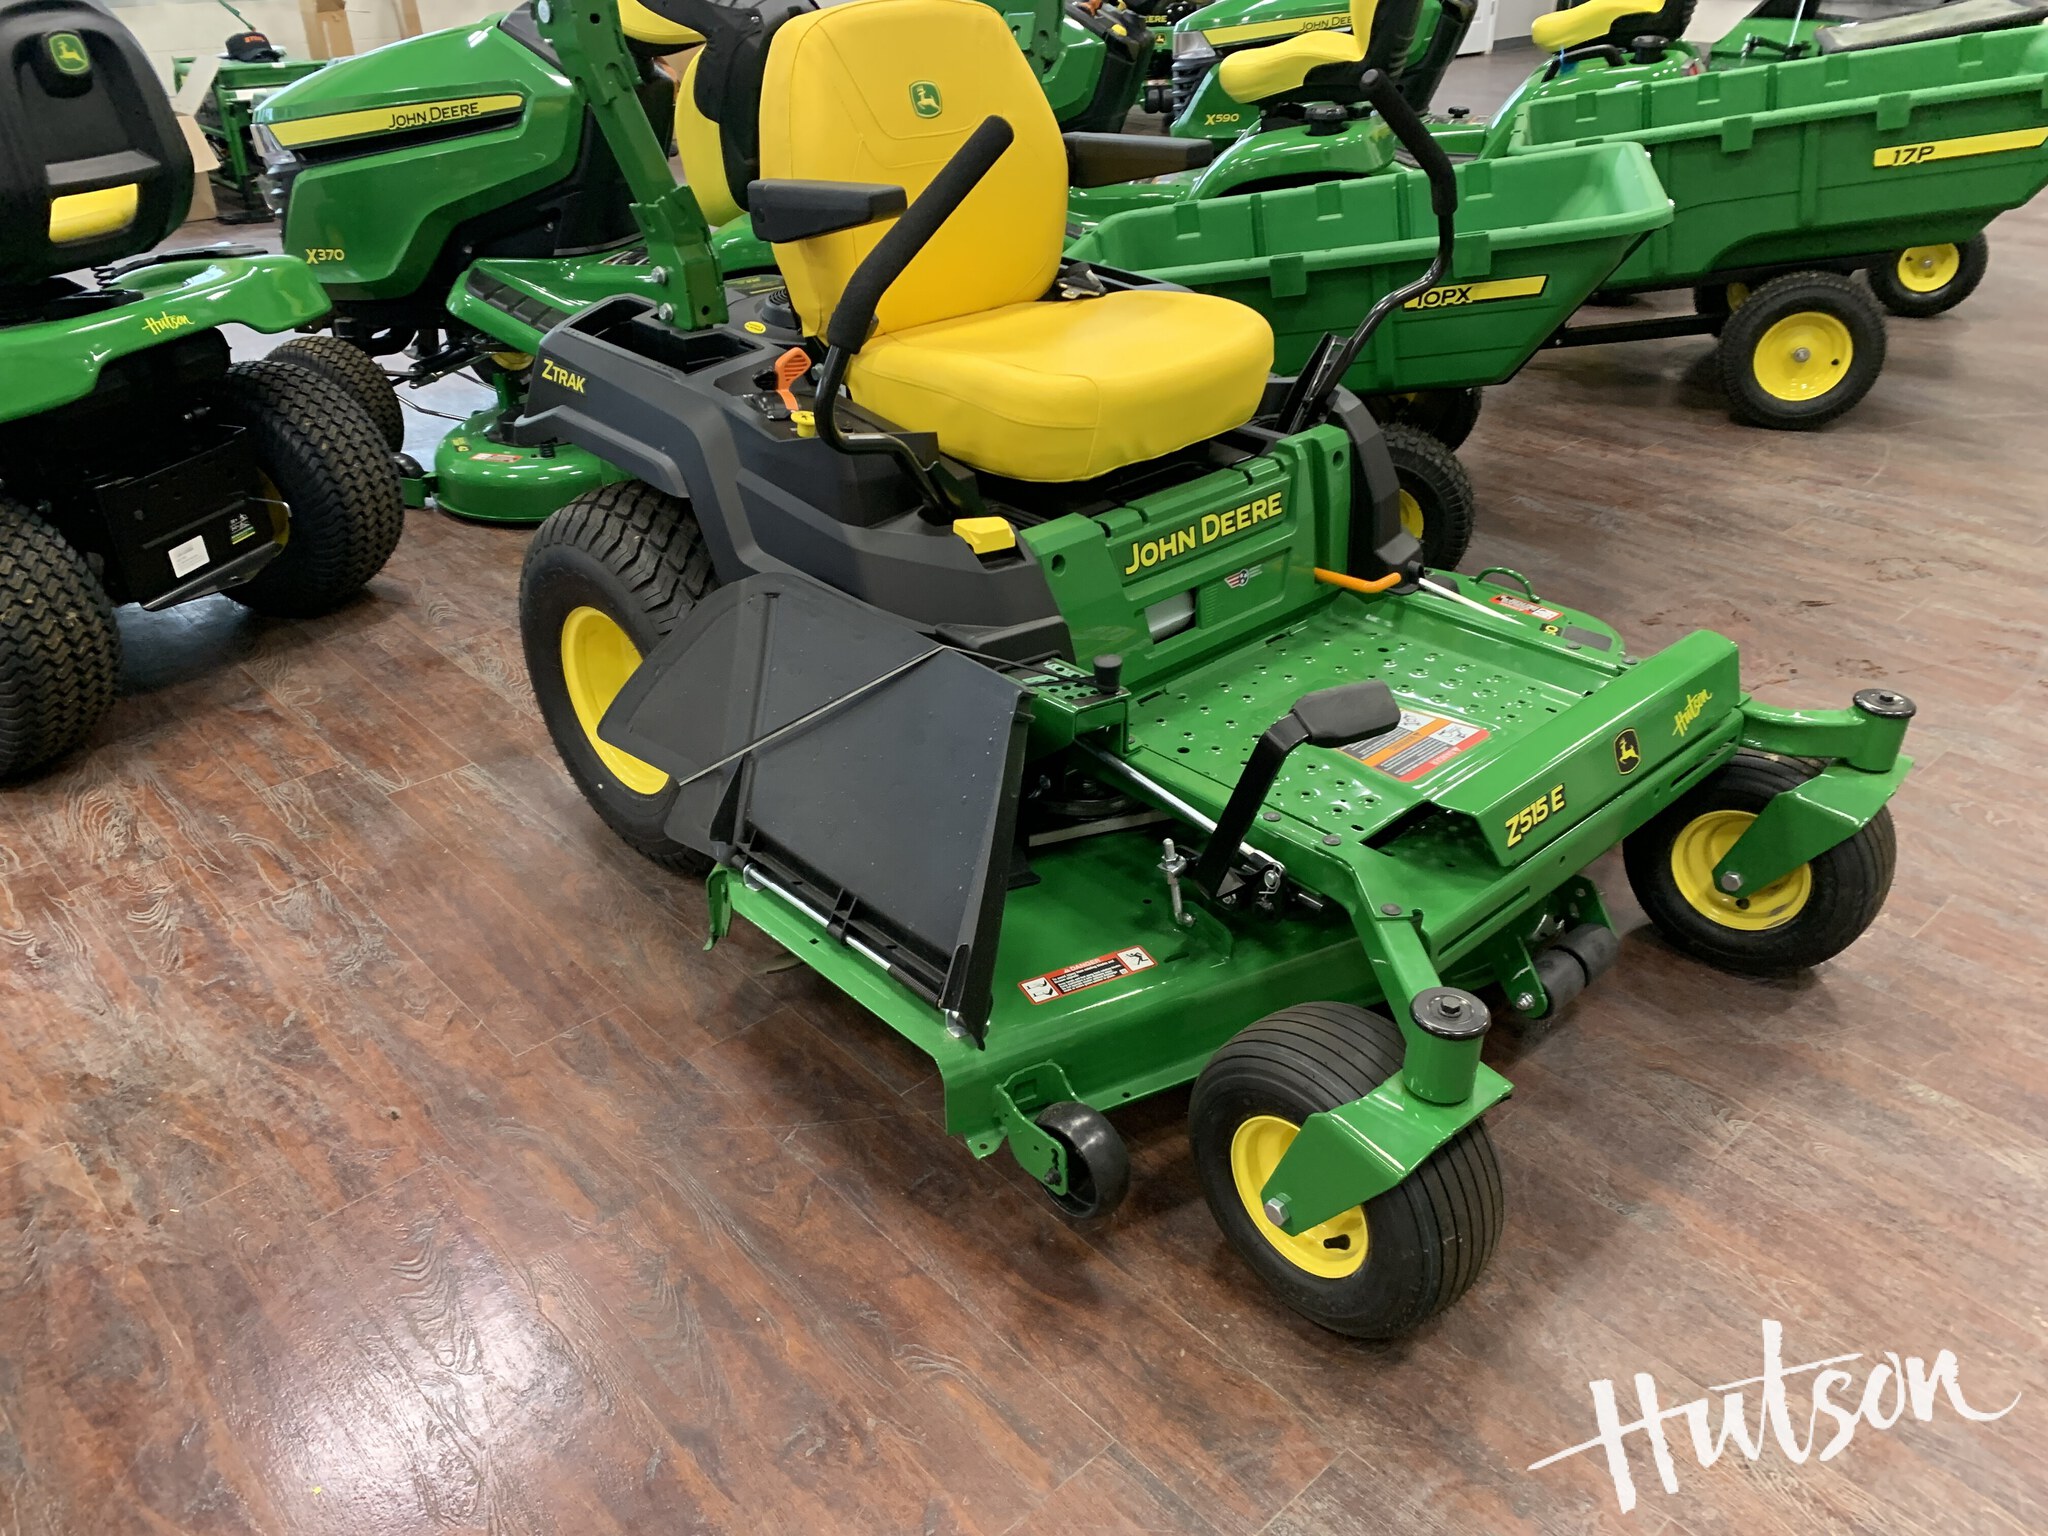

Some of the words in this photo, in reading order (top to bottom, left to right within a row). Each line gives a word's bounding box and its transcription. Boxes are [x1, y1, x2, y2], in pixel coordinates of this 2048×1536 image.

[1299, 19, 1329, 32] JOHN
[1331, 16, 1352, 26] DEE
[389, 111, 427, 128] JOHN
[430, 102, 480, 121] DEERE
[1204, 113, 1240, 125] X590
[1893, 145, 1936, 164] 17P
[305, 248, 345, 265] X370
[141, 310, 196, 335] Hutson
[541, 358, 586, 394] ZTRAK
[1125, 525, 1197, 576] JOHN
[1201, 491, 1283, 545] DEERE
[1671, 688, 1713, 738] Hutson
[1504, 795, 1549, 848] Z515
[1550, 783, 1567, 813] E
[1070, 957, 1101, 972] DANGER
